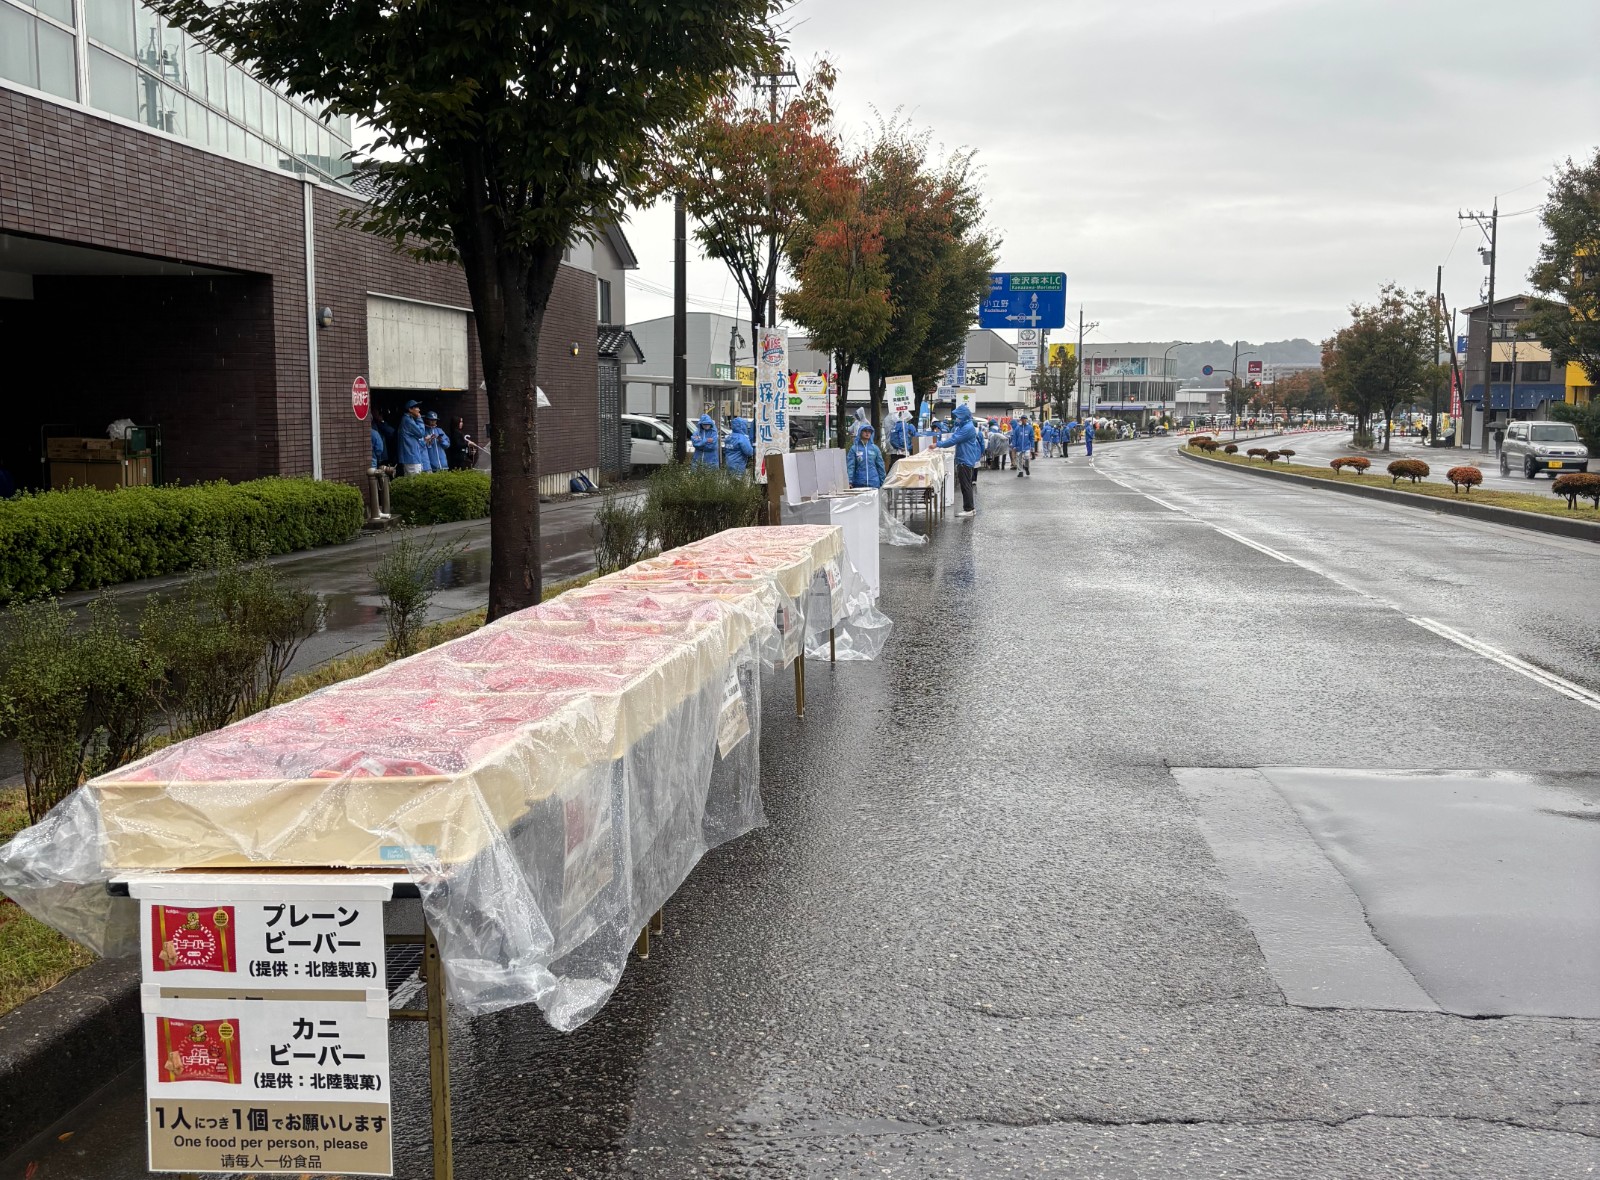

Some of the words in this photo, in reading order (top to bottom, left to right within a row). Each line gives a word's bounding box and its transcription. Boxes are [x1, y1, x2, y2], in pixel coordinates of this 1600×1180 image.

[983, 299, 1009, 308] 小立野
[760, 383, 773, 442] 探し処
[774, 371, 787, 431] お仕事
[263, 903, 360, 928] プレーン
[265, 930, 361, 954] ビーバー
[292, 1017, 340, 1040] カニ
[270, 1043, 366, 1067] ビーバー
[155, 1107, 387, 1133] 1人につき1個でお願いします
[173, 1135, 202, 1147] One
[205, 1135, 237, 1148] food
[240, 1139, 263, 1150] per
[267, 1139, 319, 1151] person,
[323, 1137, 369, 1151] please
[221, 1153, 322, 1169] 请每人一份食品
